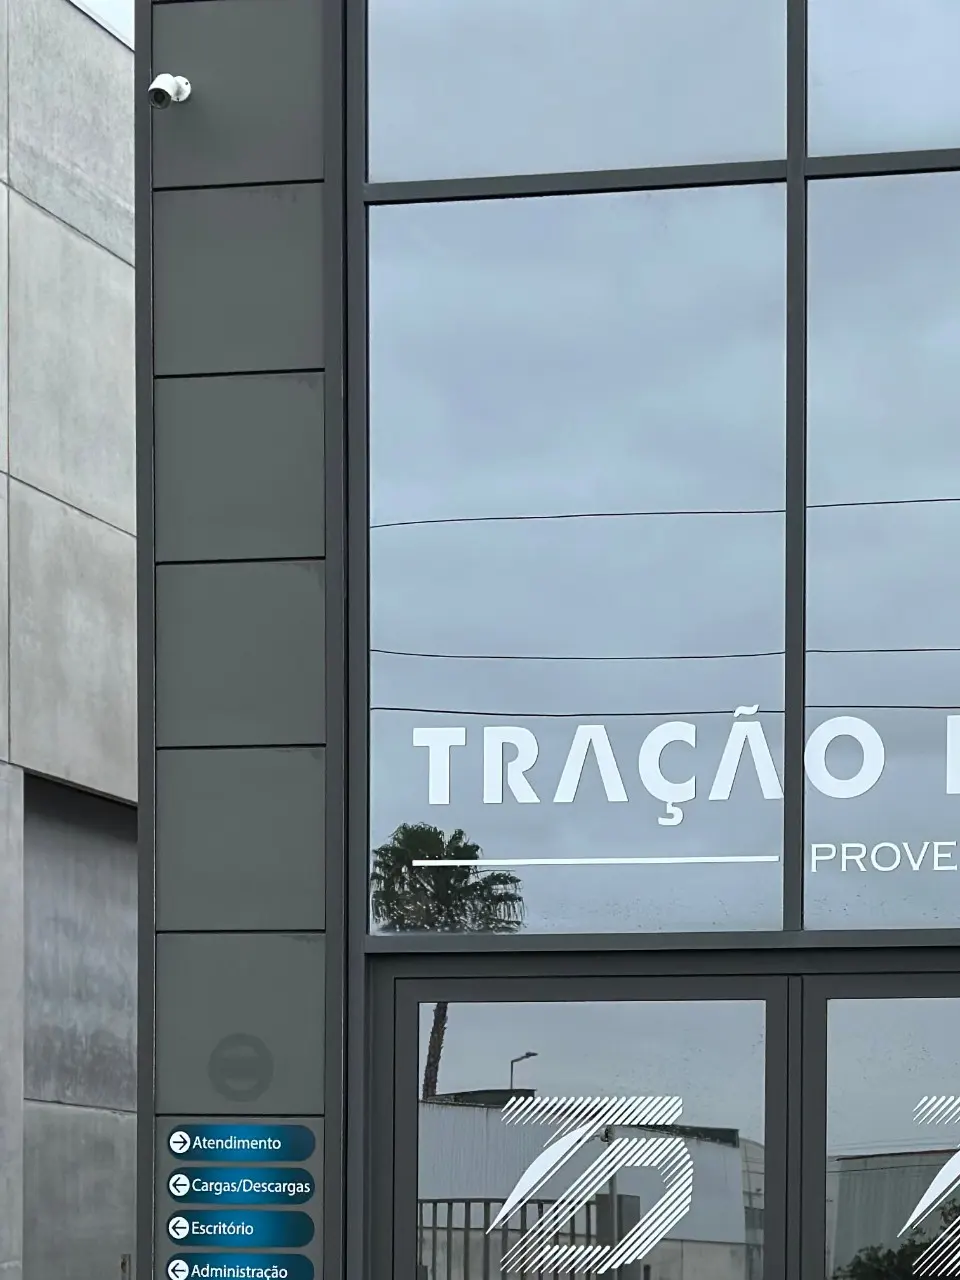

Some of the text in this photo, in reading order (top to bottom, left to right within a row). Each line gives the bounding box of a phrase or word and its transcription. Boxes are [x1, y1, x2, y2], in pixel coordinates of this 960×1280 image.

[412, 704, 886, 826] TRAÇÃO
[810, 840, 959, 873] PROVE
[192, 1136, 282, 1150] Atendimento
[191, 1178, 311, 1196] Cargas/Descargas
[191, 1221, 254, 1236] Escritório
[190, 1263, 288, 1280] Administração
